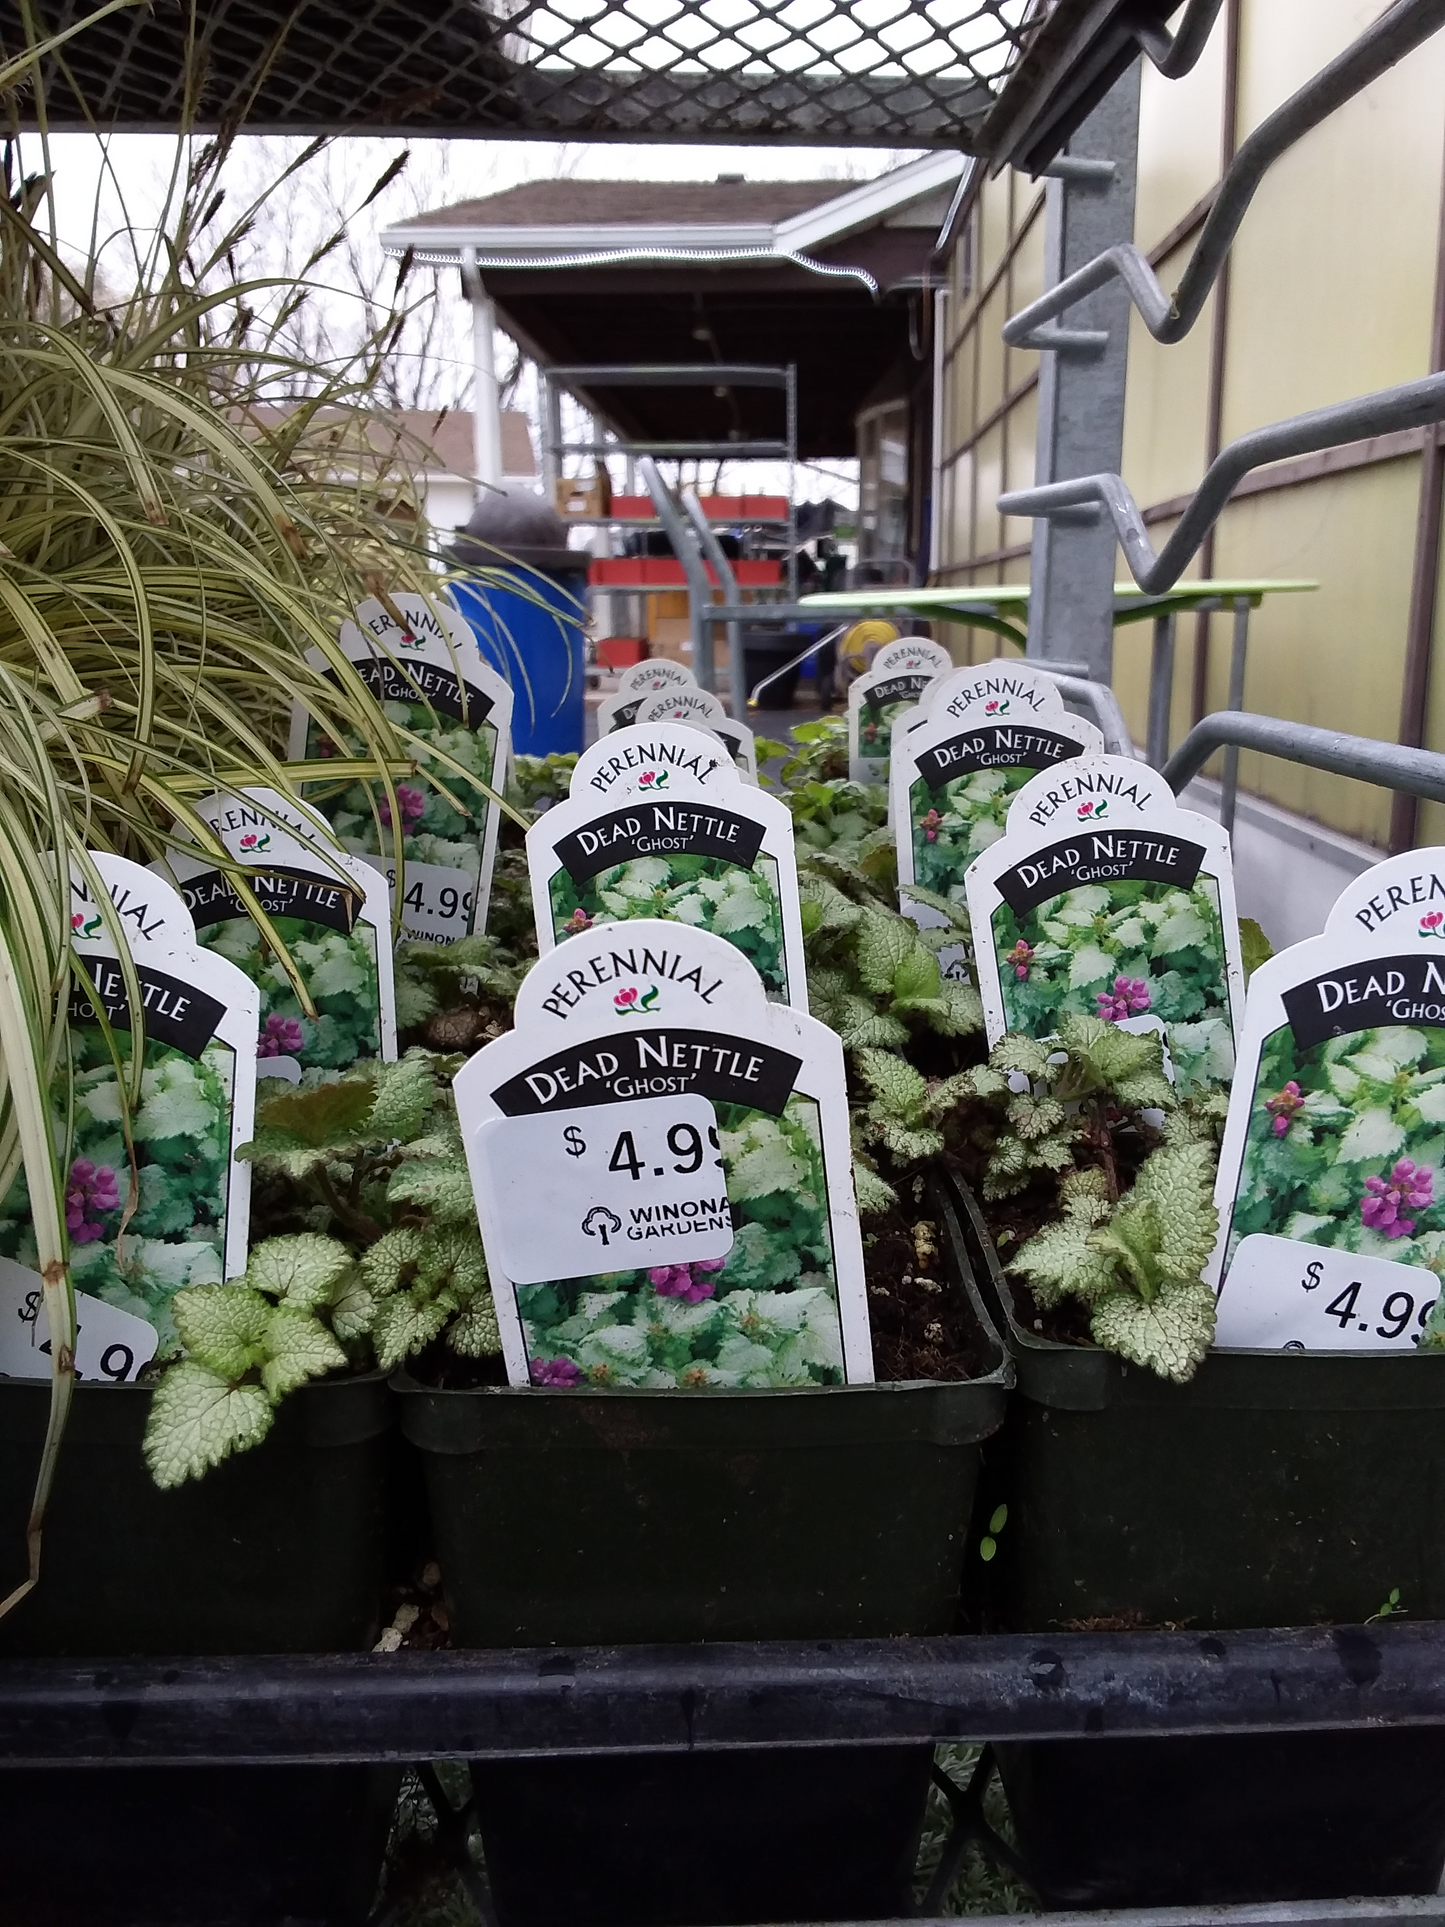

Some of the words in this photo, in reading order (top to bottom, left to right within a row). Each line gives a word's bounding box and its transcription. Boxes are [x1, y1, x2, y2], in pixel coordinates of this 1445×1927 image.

[357, 666, 396, 684] EAD
[883, 646, 943, 670] PERENNIAL
[648, 696, 714, 723] PERENNIAL
[874, 681, 906, 699] DEAD
[946, 677, 1046, 718] PERENNIAL
[589, 743, 715, 794] PERENNIAL
[933, 737, 985, 769] DEAD
[995, 729, 1065, 759] NETTLE
[1028, 772, 1153, 828] PERENNIAL
[576, 816, 641, 857] DEAD
[652, 806, 741, 845] NETTLE
[631, 832, 694, 853] 'GHOST'
[1016, 847, 1081, 889] DEAD
[1091, 835, 1181, 866] NETTLE
[1070, 860, 1134, 882] 'GHOST'
[1355, 873, 1445, 933] PEREN
[407, 929, 456, 945] WINON
[73, 962, 192, 1022] NETLE
[541, 947, 725, 1020] PERENNIAL
[1316, 970, 1405, 1013] DEAD
[524, 1050, 619, 1105] DEAD
[634, 1035, 765, 1084] NETTLE
[605, 1072, 698, 1098] 'GHOST'
[563, 1125, 587, 1159] $
[1301, 1261, 1324, 1294] $
